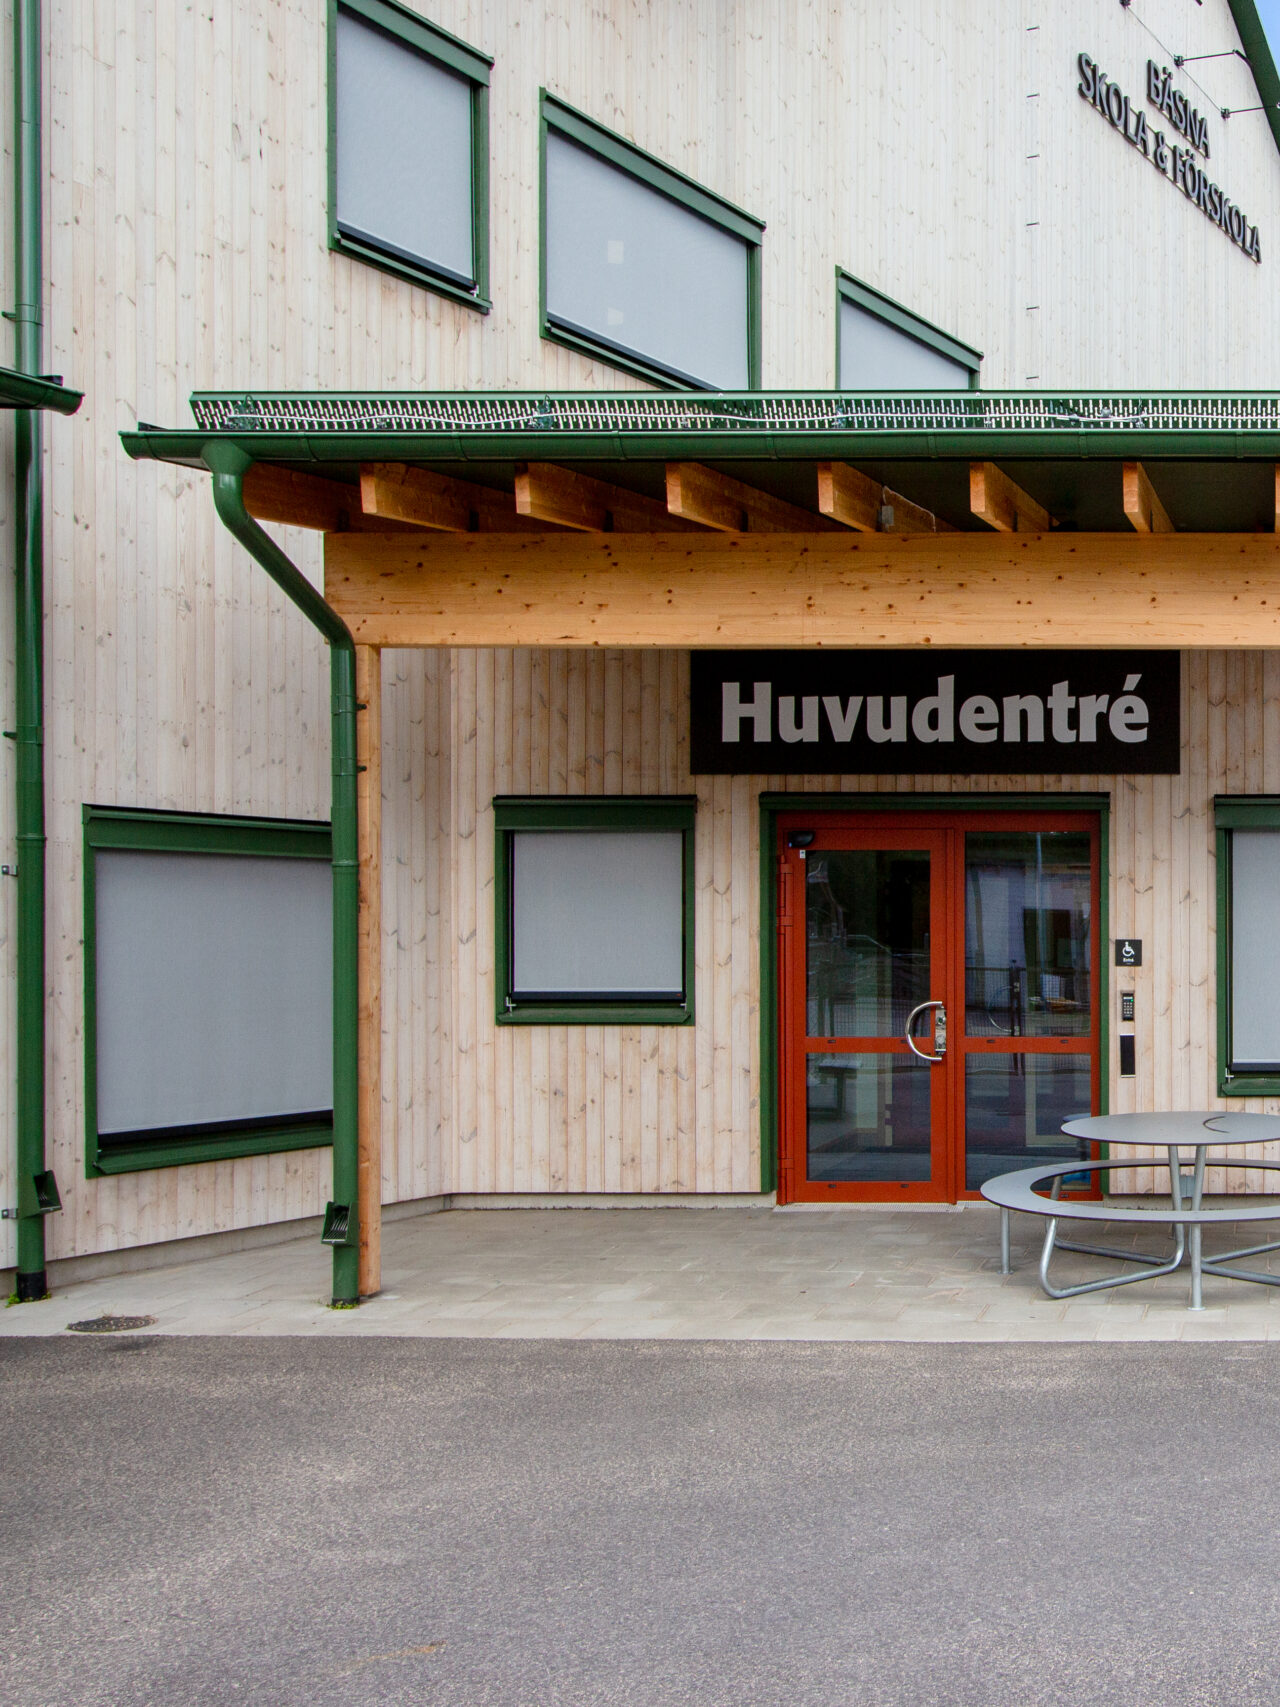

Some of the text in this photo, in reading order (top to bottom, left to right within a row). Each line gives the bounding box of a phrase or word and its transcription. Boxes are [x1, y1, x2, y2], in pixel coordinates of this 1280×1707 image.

[1078, 53, 1262, 264] SKOLA & FÖRSKOLA
[1146, 59, 1210, 159] BÄSNA
[721, 674, 1150, 744] Huvudentré
